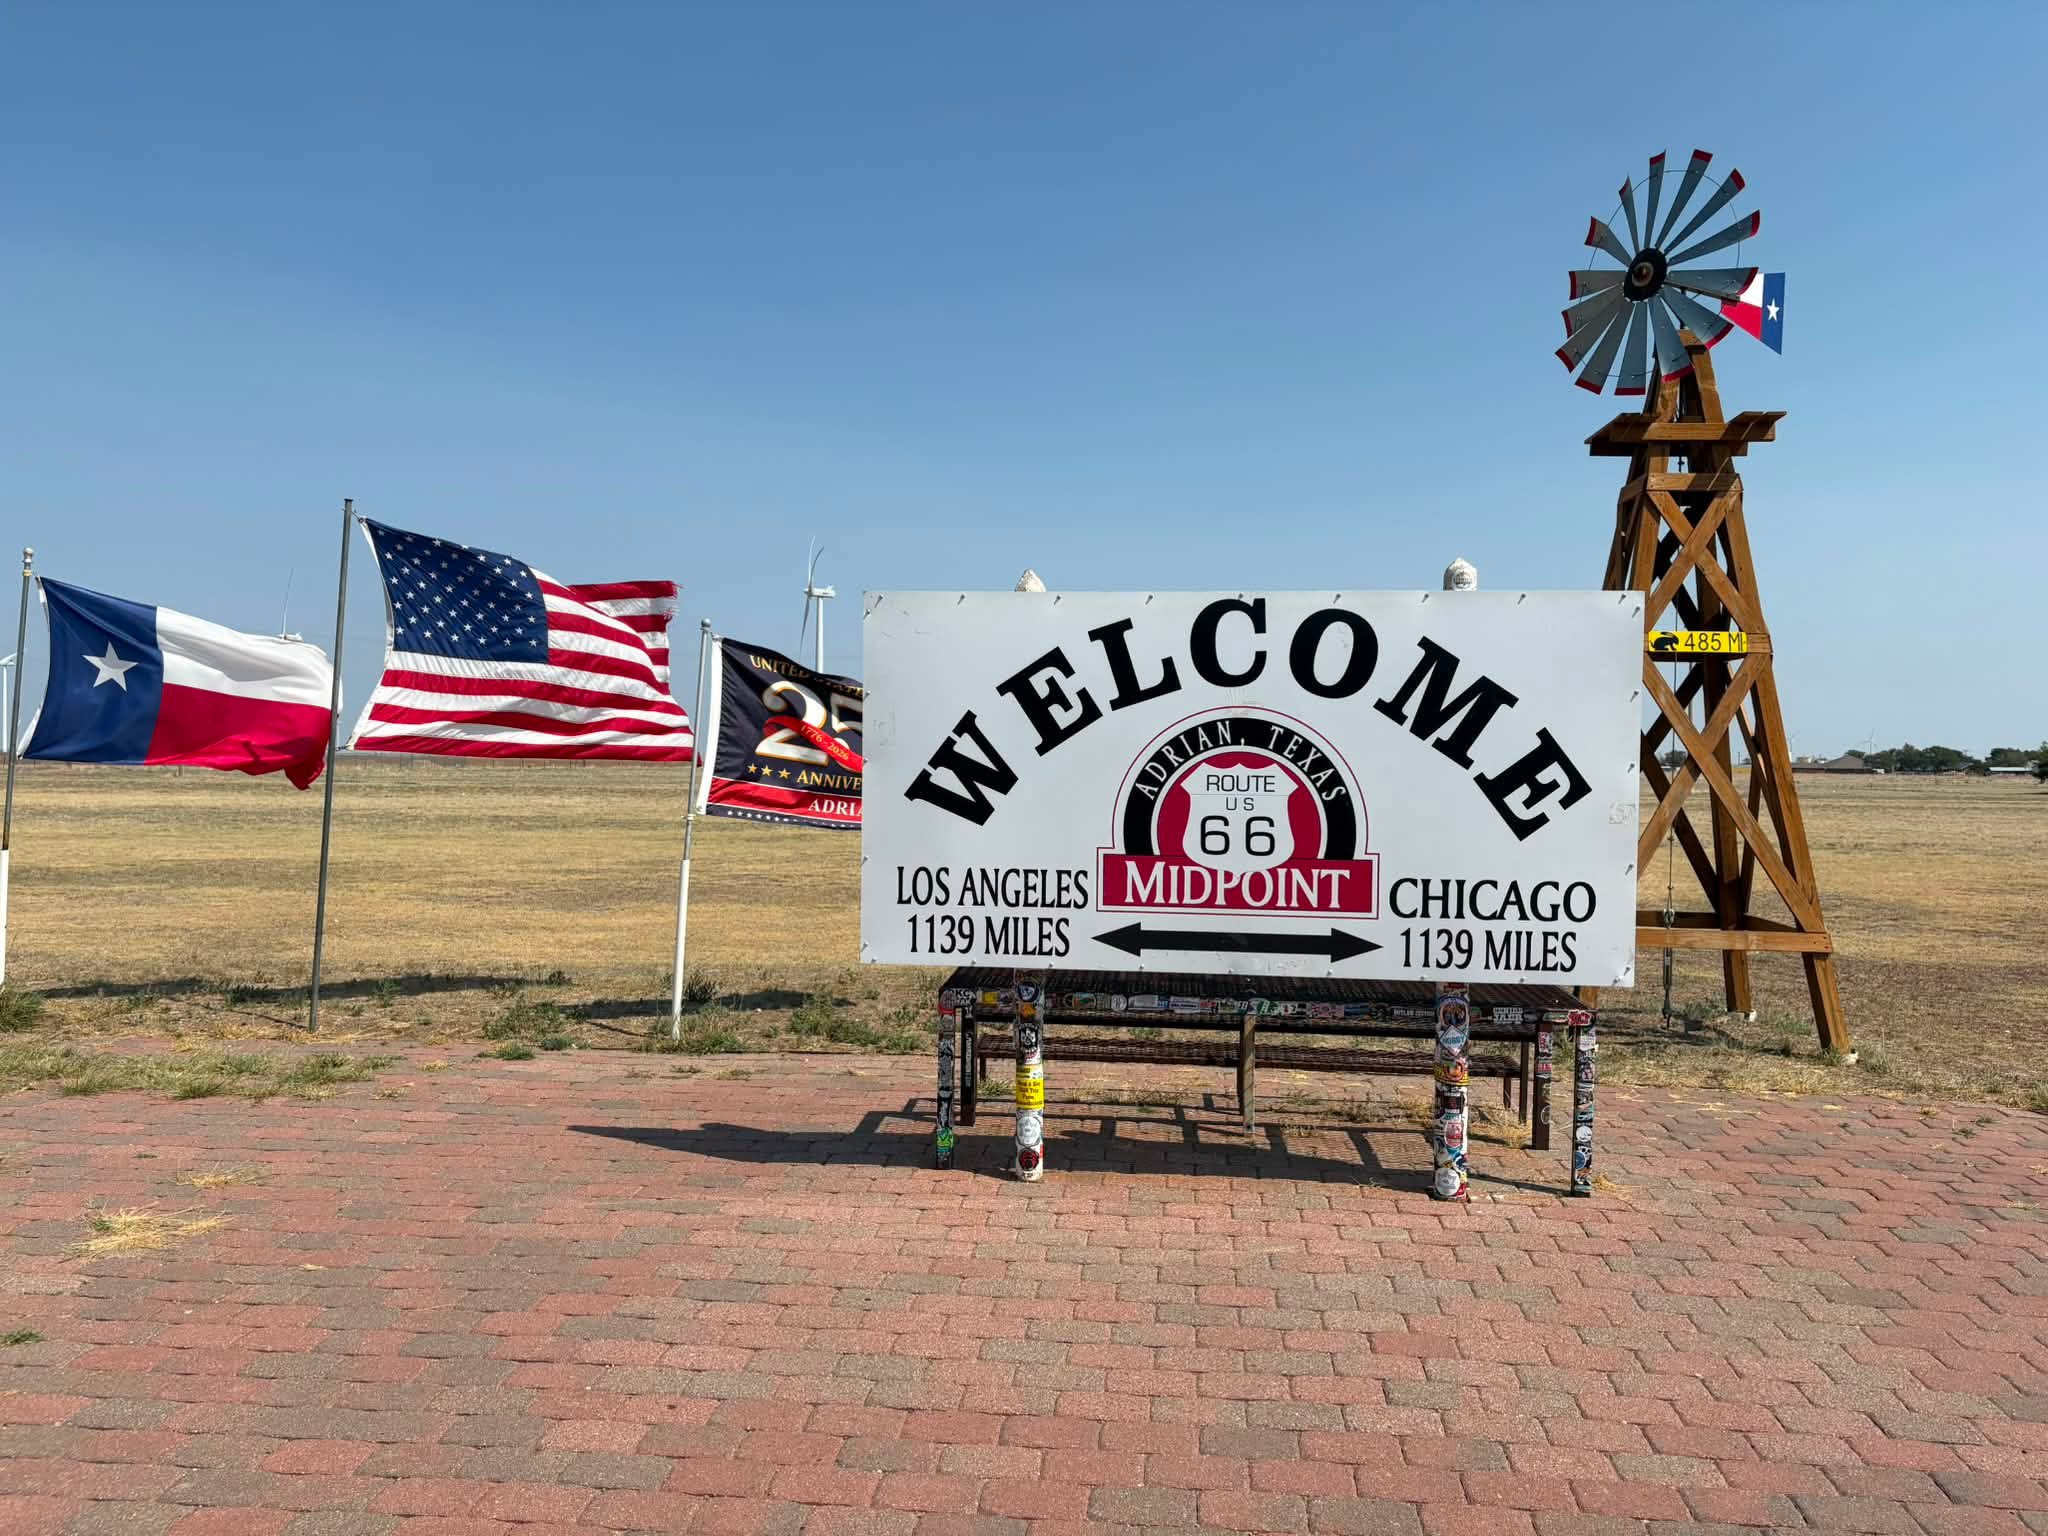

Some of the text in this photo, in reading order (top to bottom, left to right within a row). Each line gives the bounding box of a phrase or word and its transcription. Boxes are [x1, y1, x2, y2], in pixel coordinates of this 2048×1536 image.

[1684, 632, 1722, 651] 485
[904, 597, 1592, 842] WELCOME
[1135, 720, 1347, 802] ADRIAN, TEXAS
[1205, 774, 1276, 793] ROUTE
[1200, 815, 1276, 857] 66
[897, 866, 1089, 909] LOS ANGELES
[1124, 860, 1351, 909] MIDPOINT
[1389, 878, 1597, 923] CHICAGO
[907, 914, 1071, 957] 1139 MILES
[1400, 928, 1577, 972] 1139 MILES
